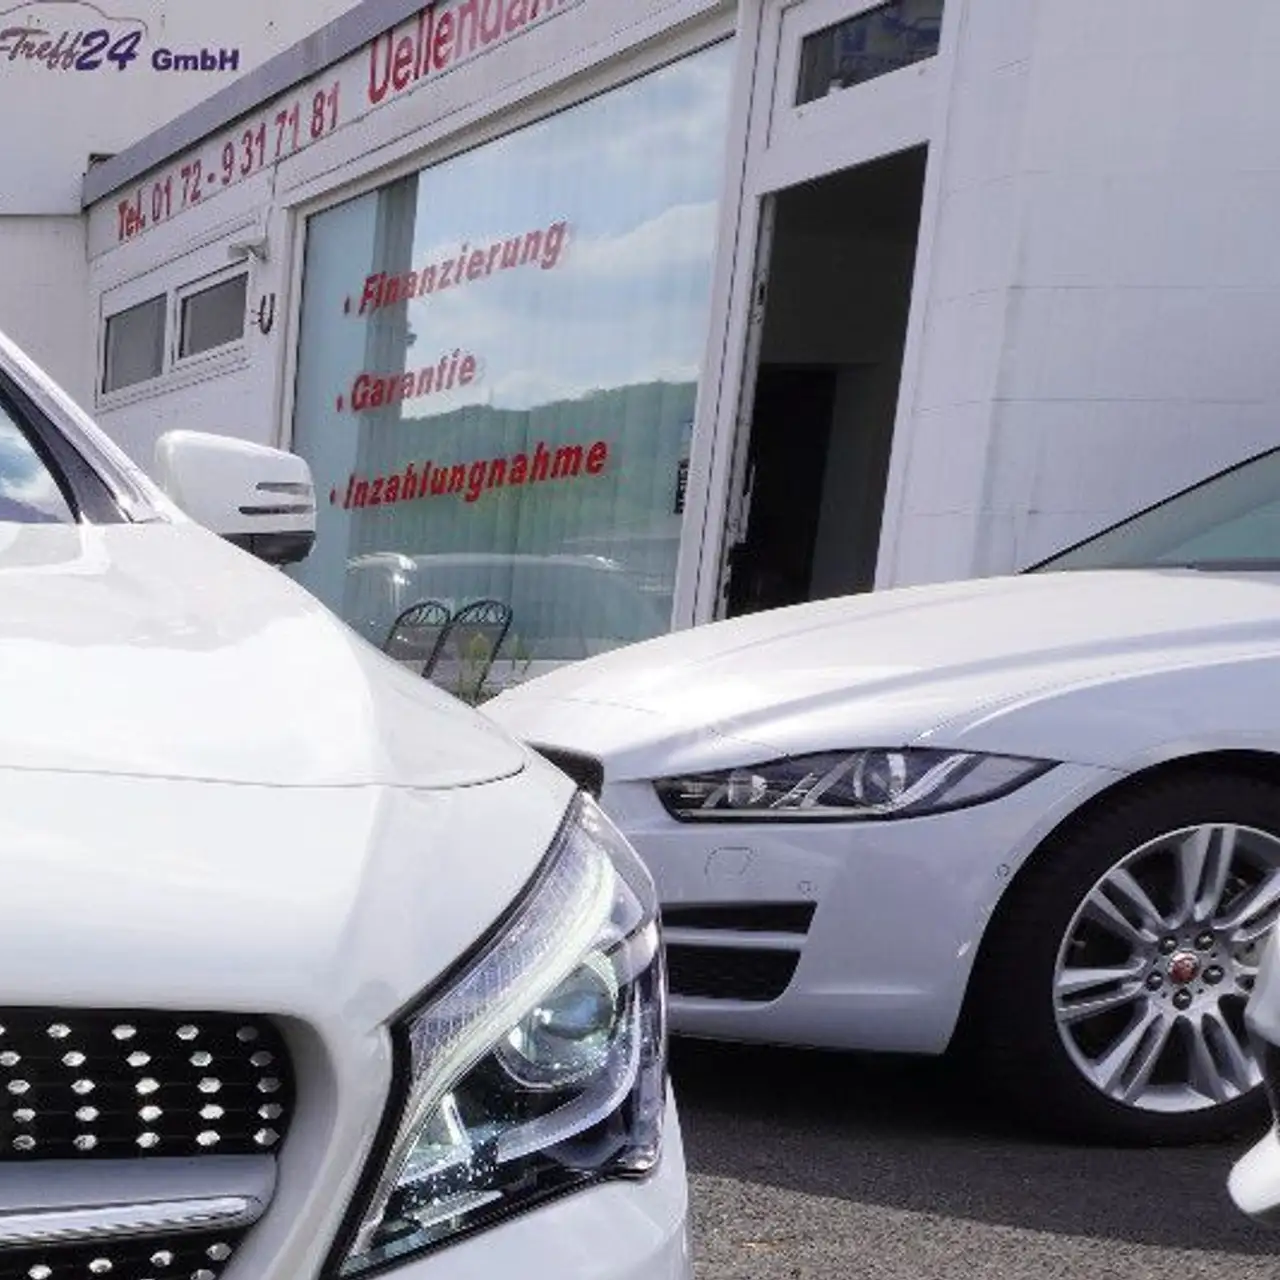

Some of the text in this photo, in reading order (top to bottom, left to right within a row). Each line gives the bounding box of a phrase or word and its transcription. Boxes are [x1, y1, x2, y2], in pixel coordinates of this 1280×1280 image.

[151, 47, 240, 71] GmbH
[358, 220, 566, 315] Finanzierung
[351, 348, 477, 412] Garantie
[344, 440, 608, 509] Inzahlungnahme
